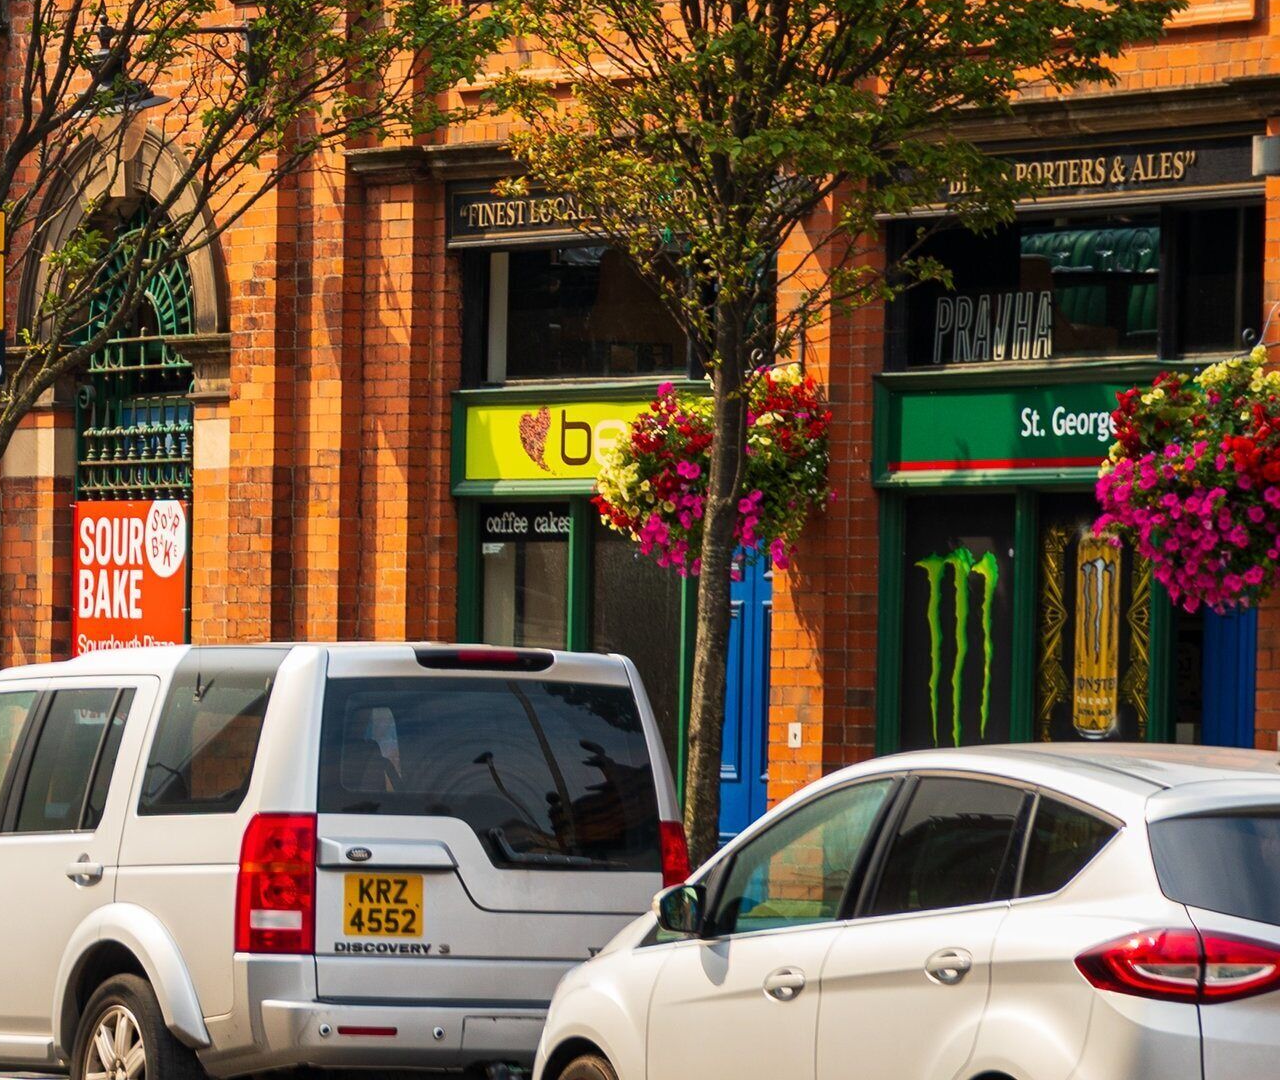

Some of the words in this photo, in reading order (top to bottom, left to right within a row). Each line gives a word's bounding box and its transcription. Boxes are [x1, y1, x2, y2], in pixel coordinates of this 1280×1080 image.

[1015, 156, 1107, 190] PORTERS
[1110, 155, 1126, 183] &
[932, 290, 1053, 364] PRAVHA
[1020, 406, 1046, 438] St.
[151, 505, 180, 537] SOUR
[486, 511, 529, 534] coffee
[534, 511, 573, 534] cakes
[79, 516, 144, 566] SOUR
[151, 534, 179, 568] BAKE
[78, 569, 144, 619] BAKE
[358, 877, 409, 905] KRZ
[349, 907, 417, 934] 4552
[334, 940, 432, 955] DISCOVERY
